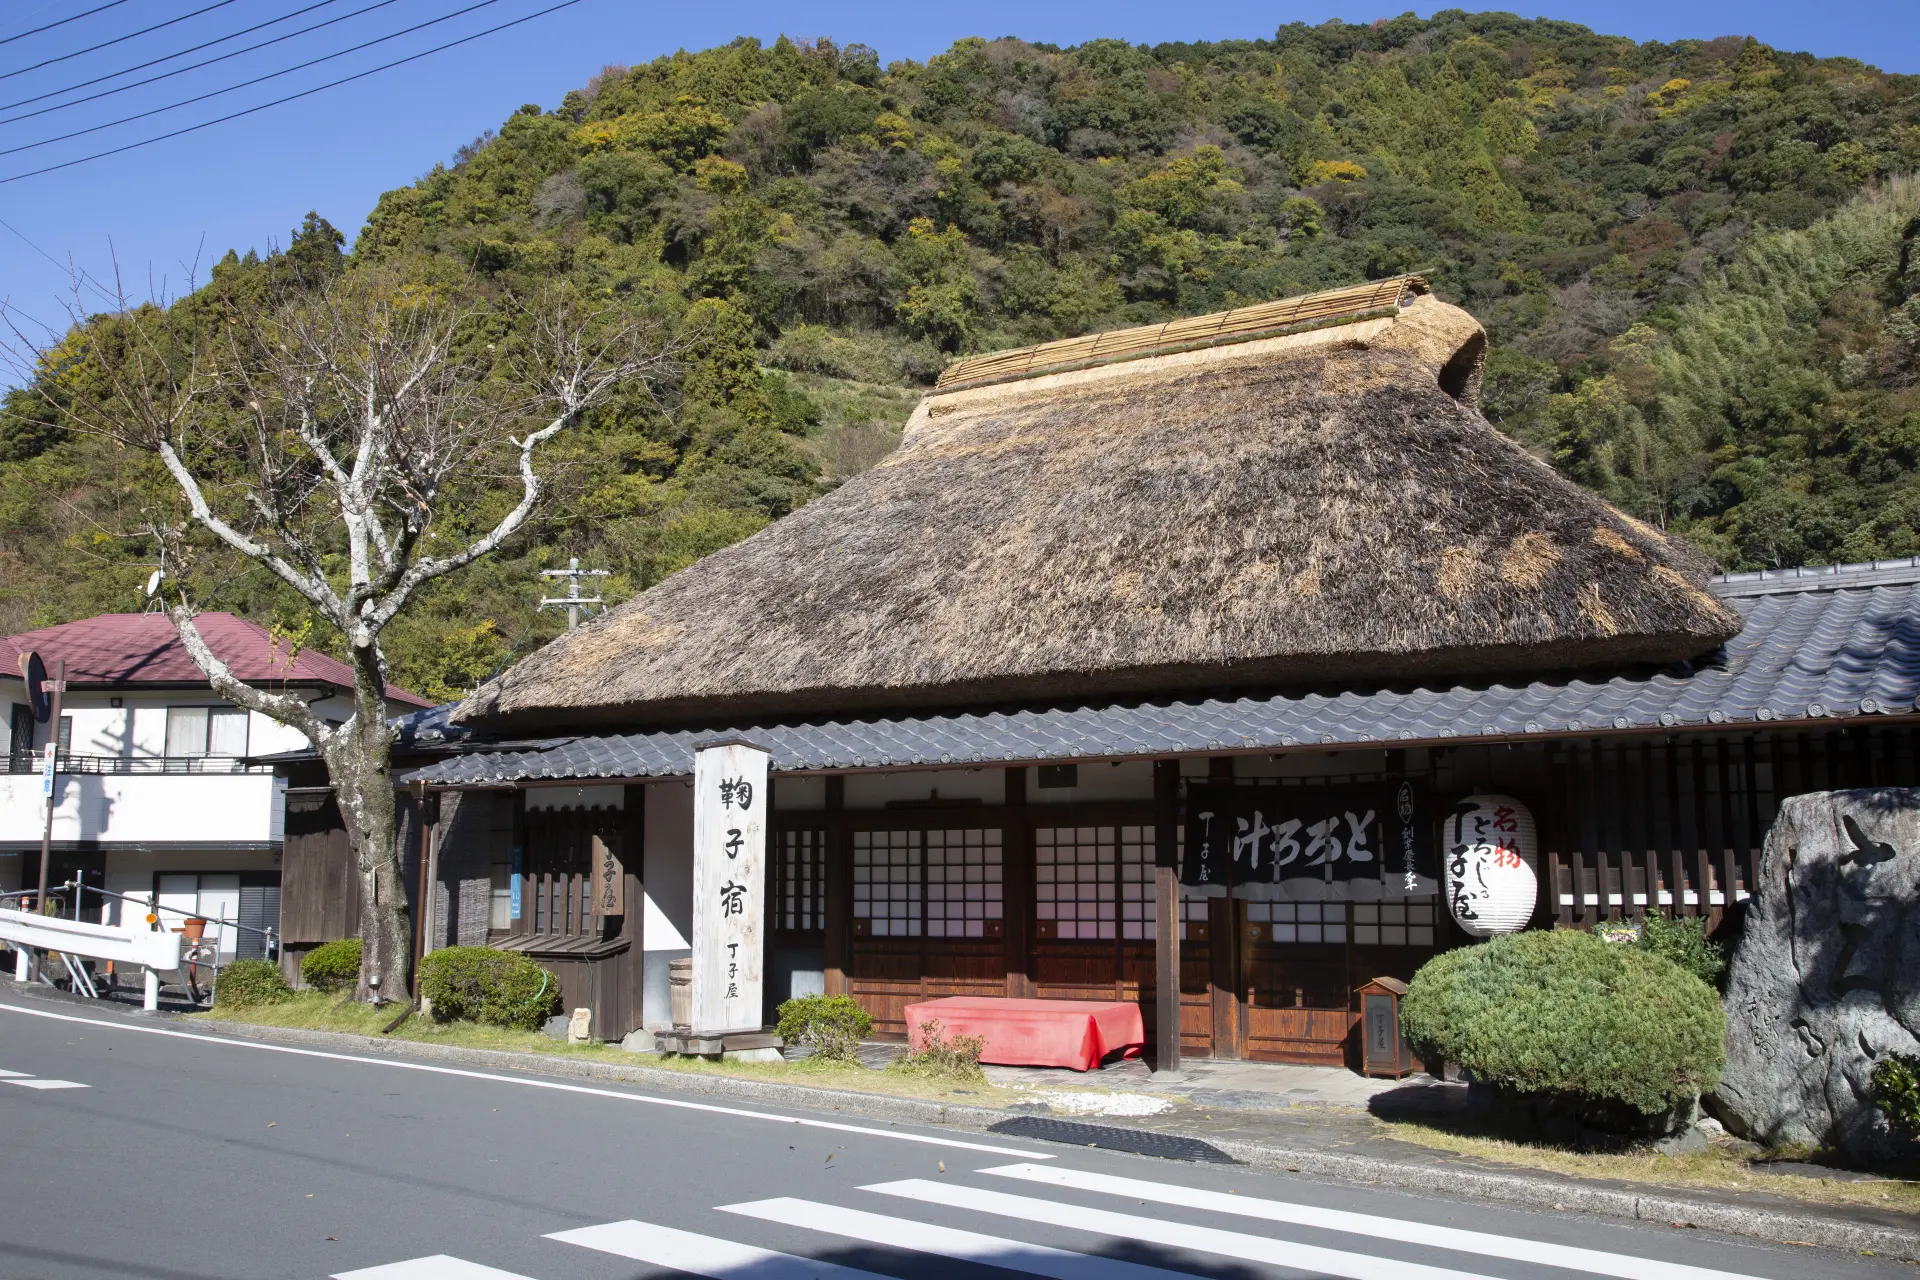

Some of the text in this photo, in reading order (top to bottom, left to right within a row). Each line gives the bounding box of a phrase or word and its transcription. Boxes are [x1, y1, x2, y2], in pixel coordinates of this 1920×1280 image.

[1198, 810, 1215, 882] 丁子屋
[1444, 802, 1480, 920] 丁子屋
[1492, 805, 1522, 869] 名物
[718, 775, 753, 999] 鞠子宿 丁子屋
[1375, 1013, 1386, 1050] 丁子屋
